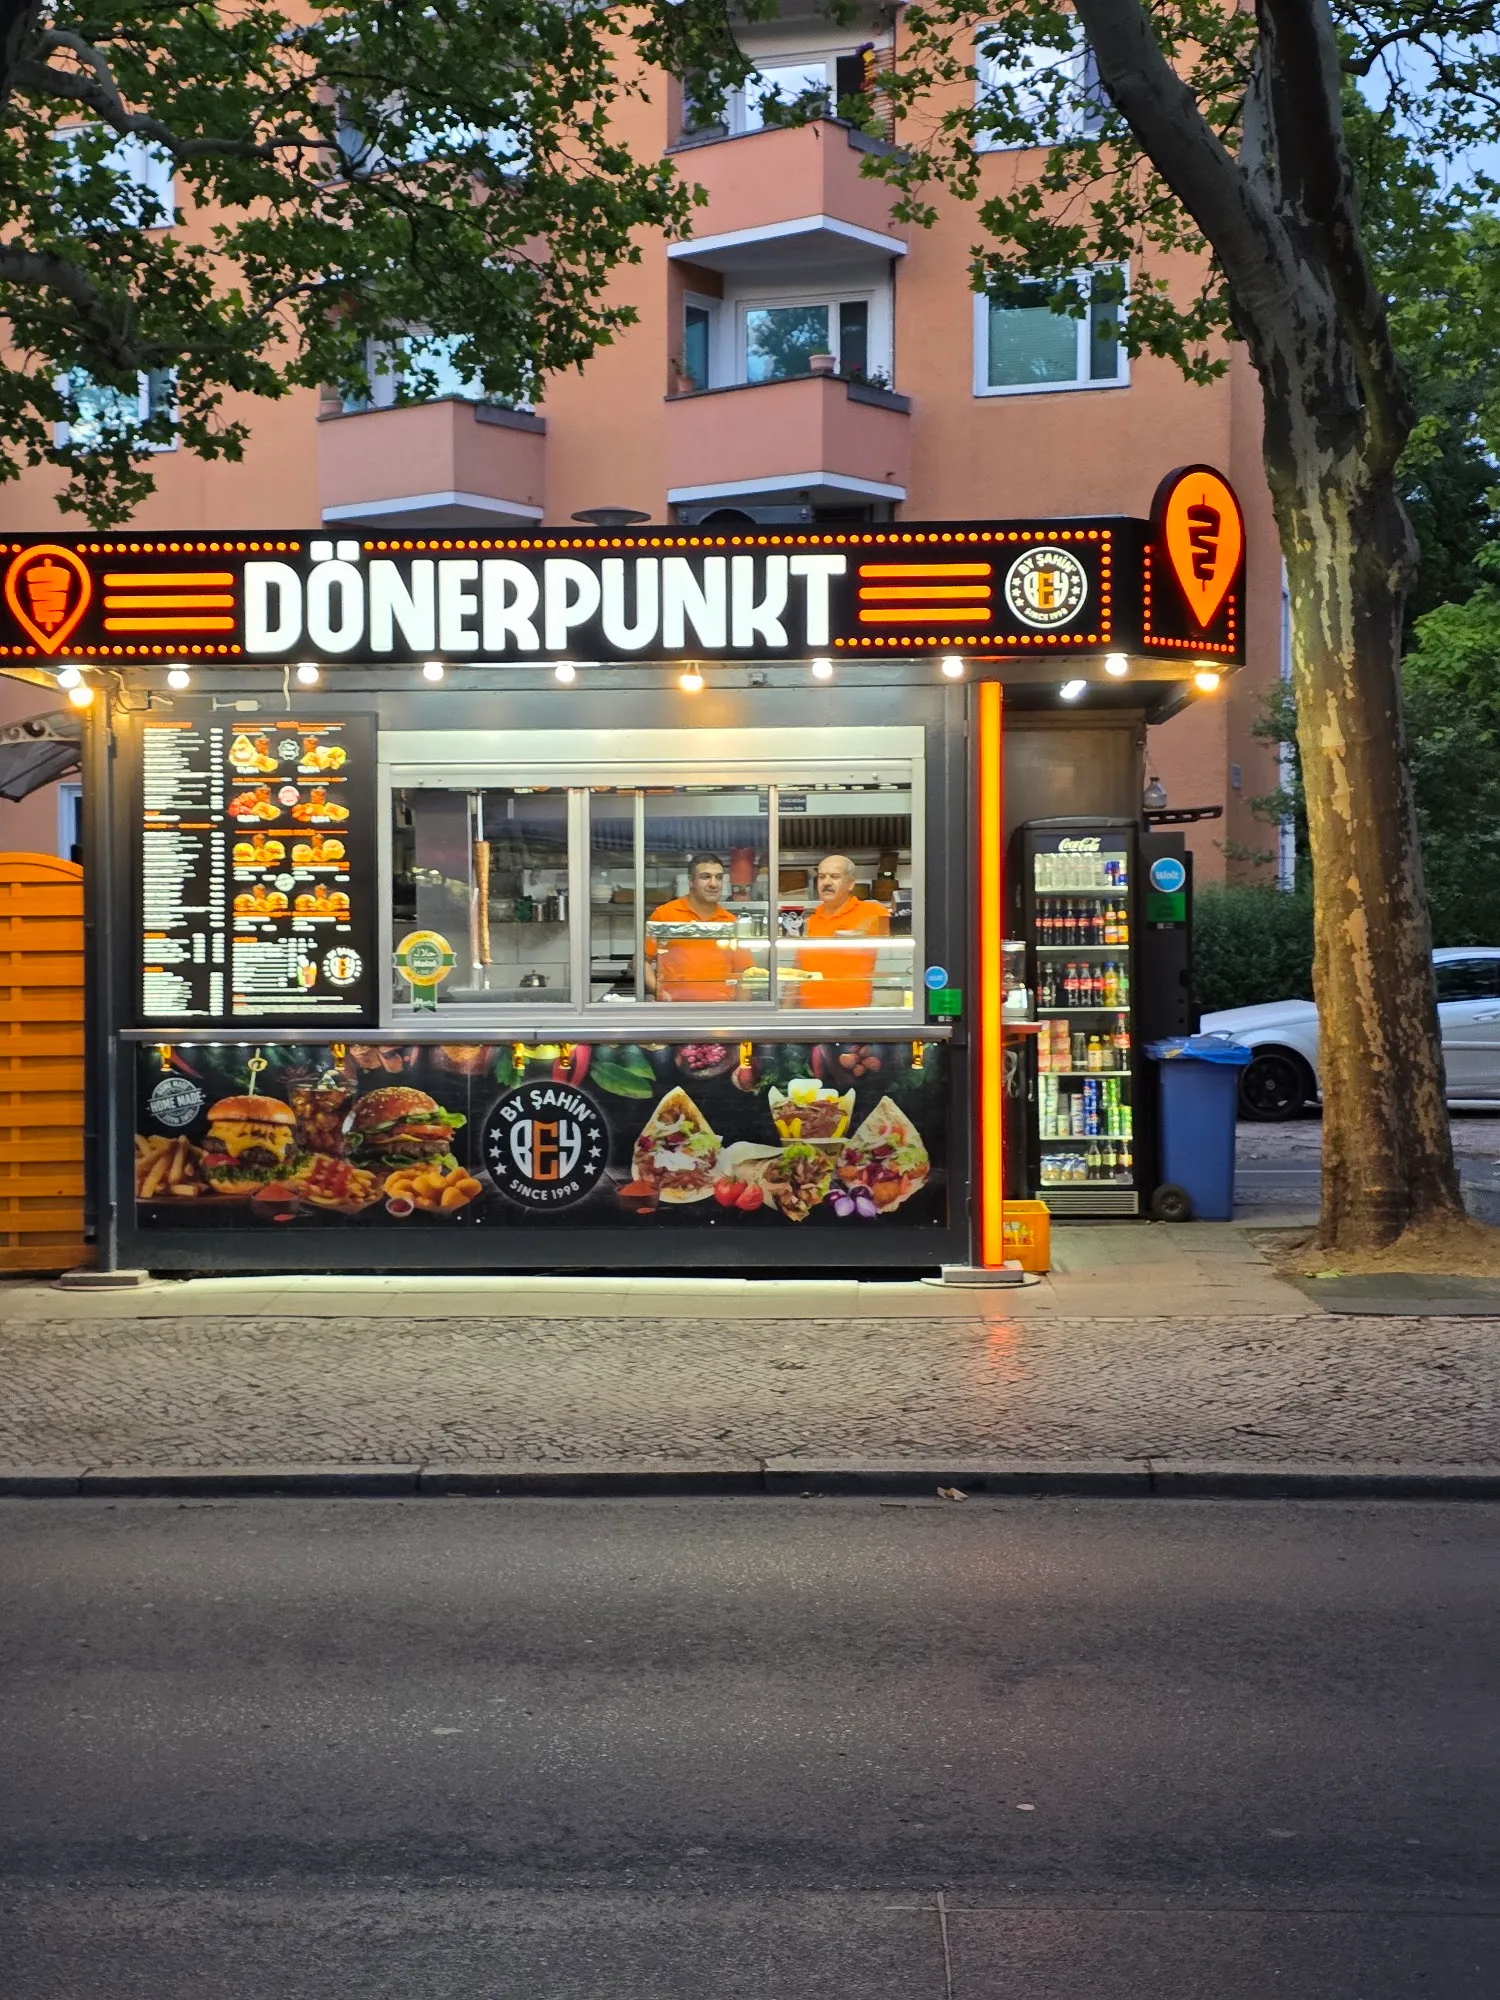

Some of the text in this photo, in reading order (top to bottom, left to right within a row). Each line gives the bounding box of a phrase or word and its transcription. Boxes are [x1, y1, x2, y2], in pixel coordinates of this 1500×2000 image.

[244, 540, 847, 653] DÖNERPUNKT
[150, 1091, 204, 1113] HOME MADE
[500, 1095, 524, 1122] BY
[509, 1179, 580, 1200] SINCE 1998
